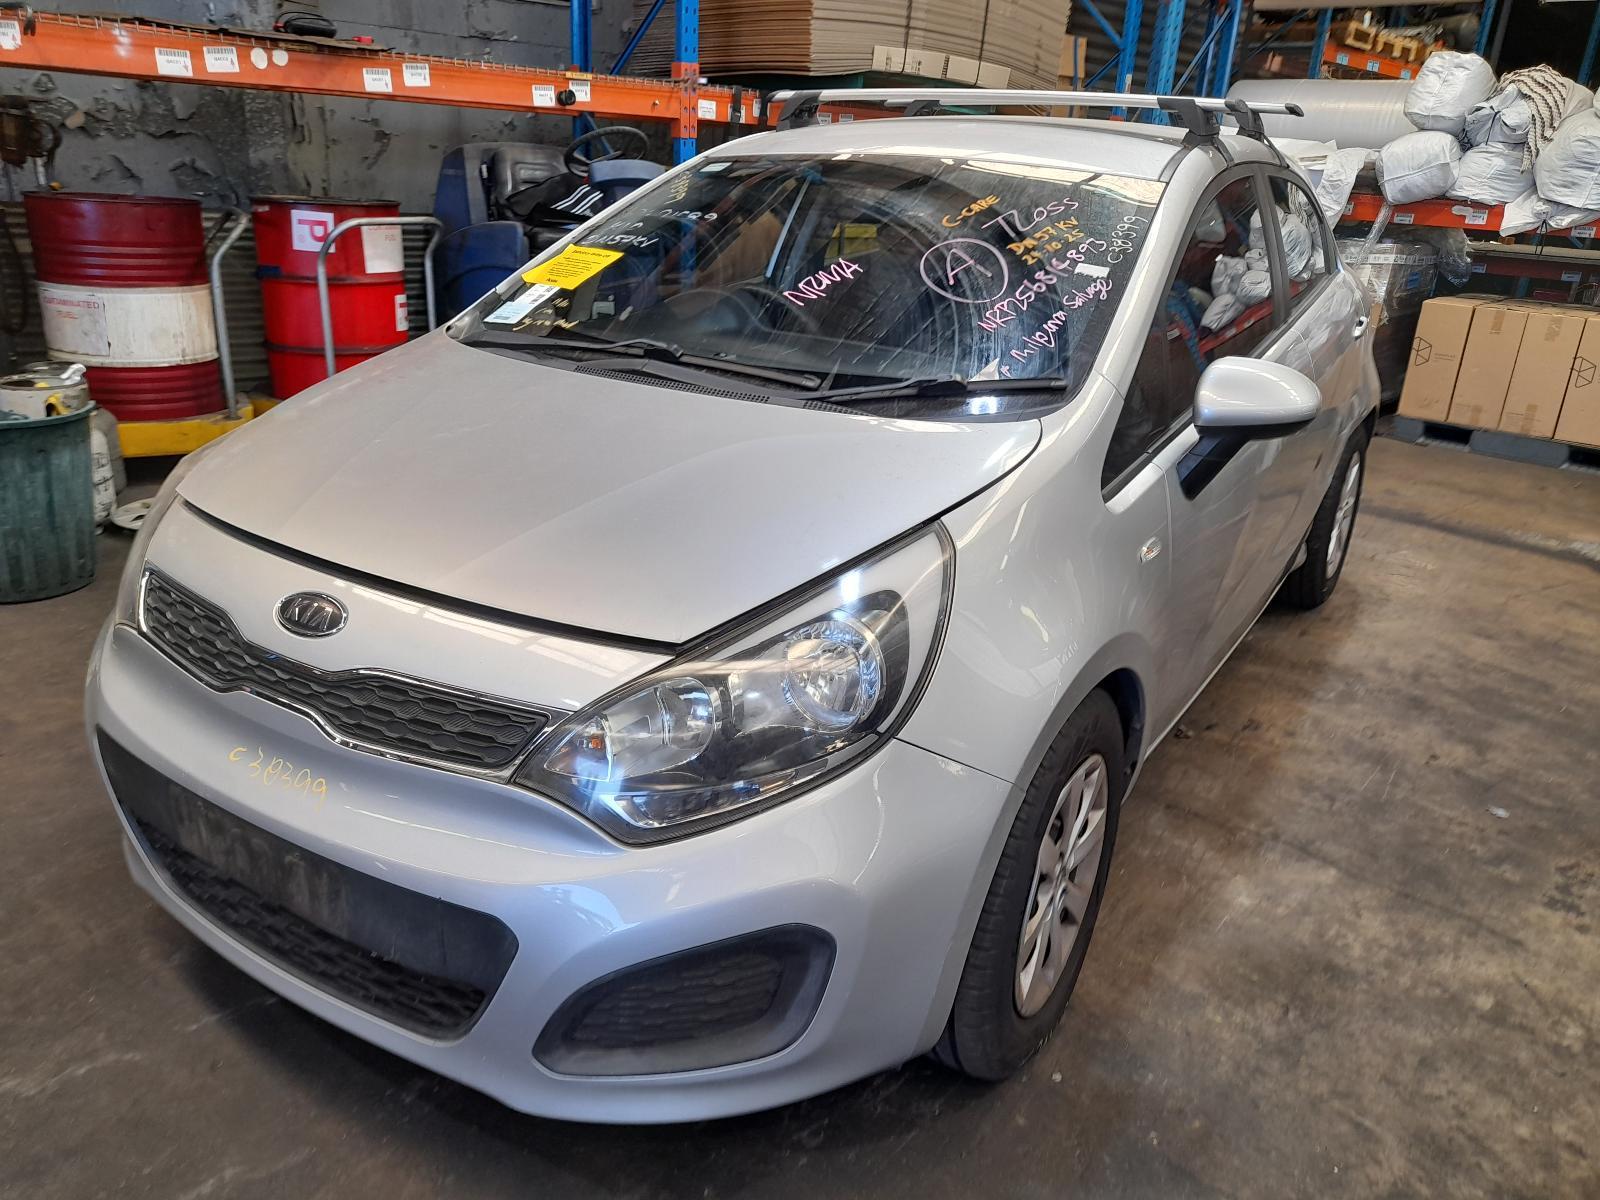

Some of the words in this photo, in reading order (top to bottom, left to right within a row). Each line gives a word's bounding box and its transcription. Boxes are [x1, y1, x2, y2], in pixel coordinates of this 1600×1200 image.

[1107, 215, 1149, 264] C38399
[782, 257, 863, 306] NRMA
[283, 597, 334, 631] KIA
